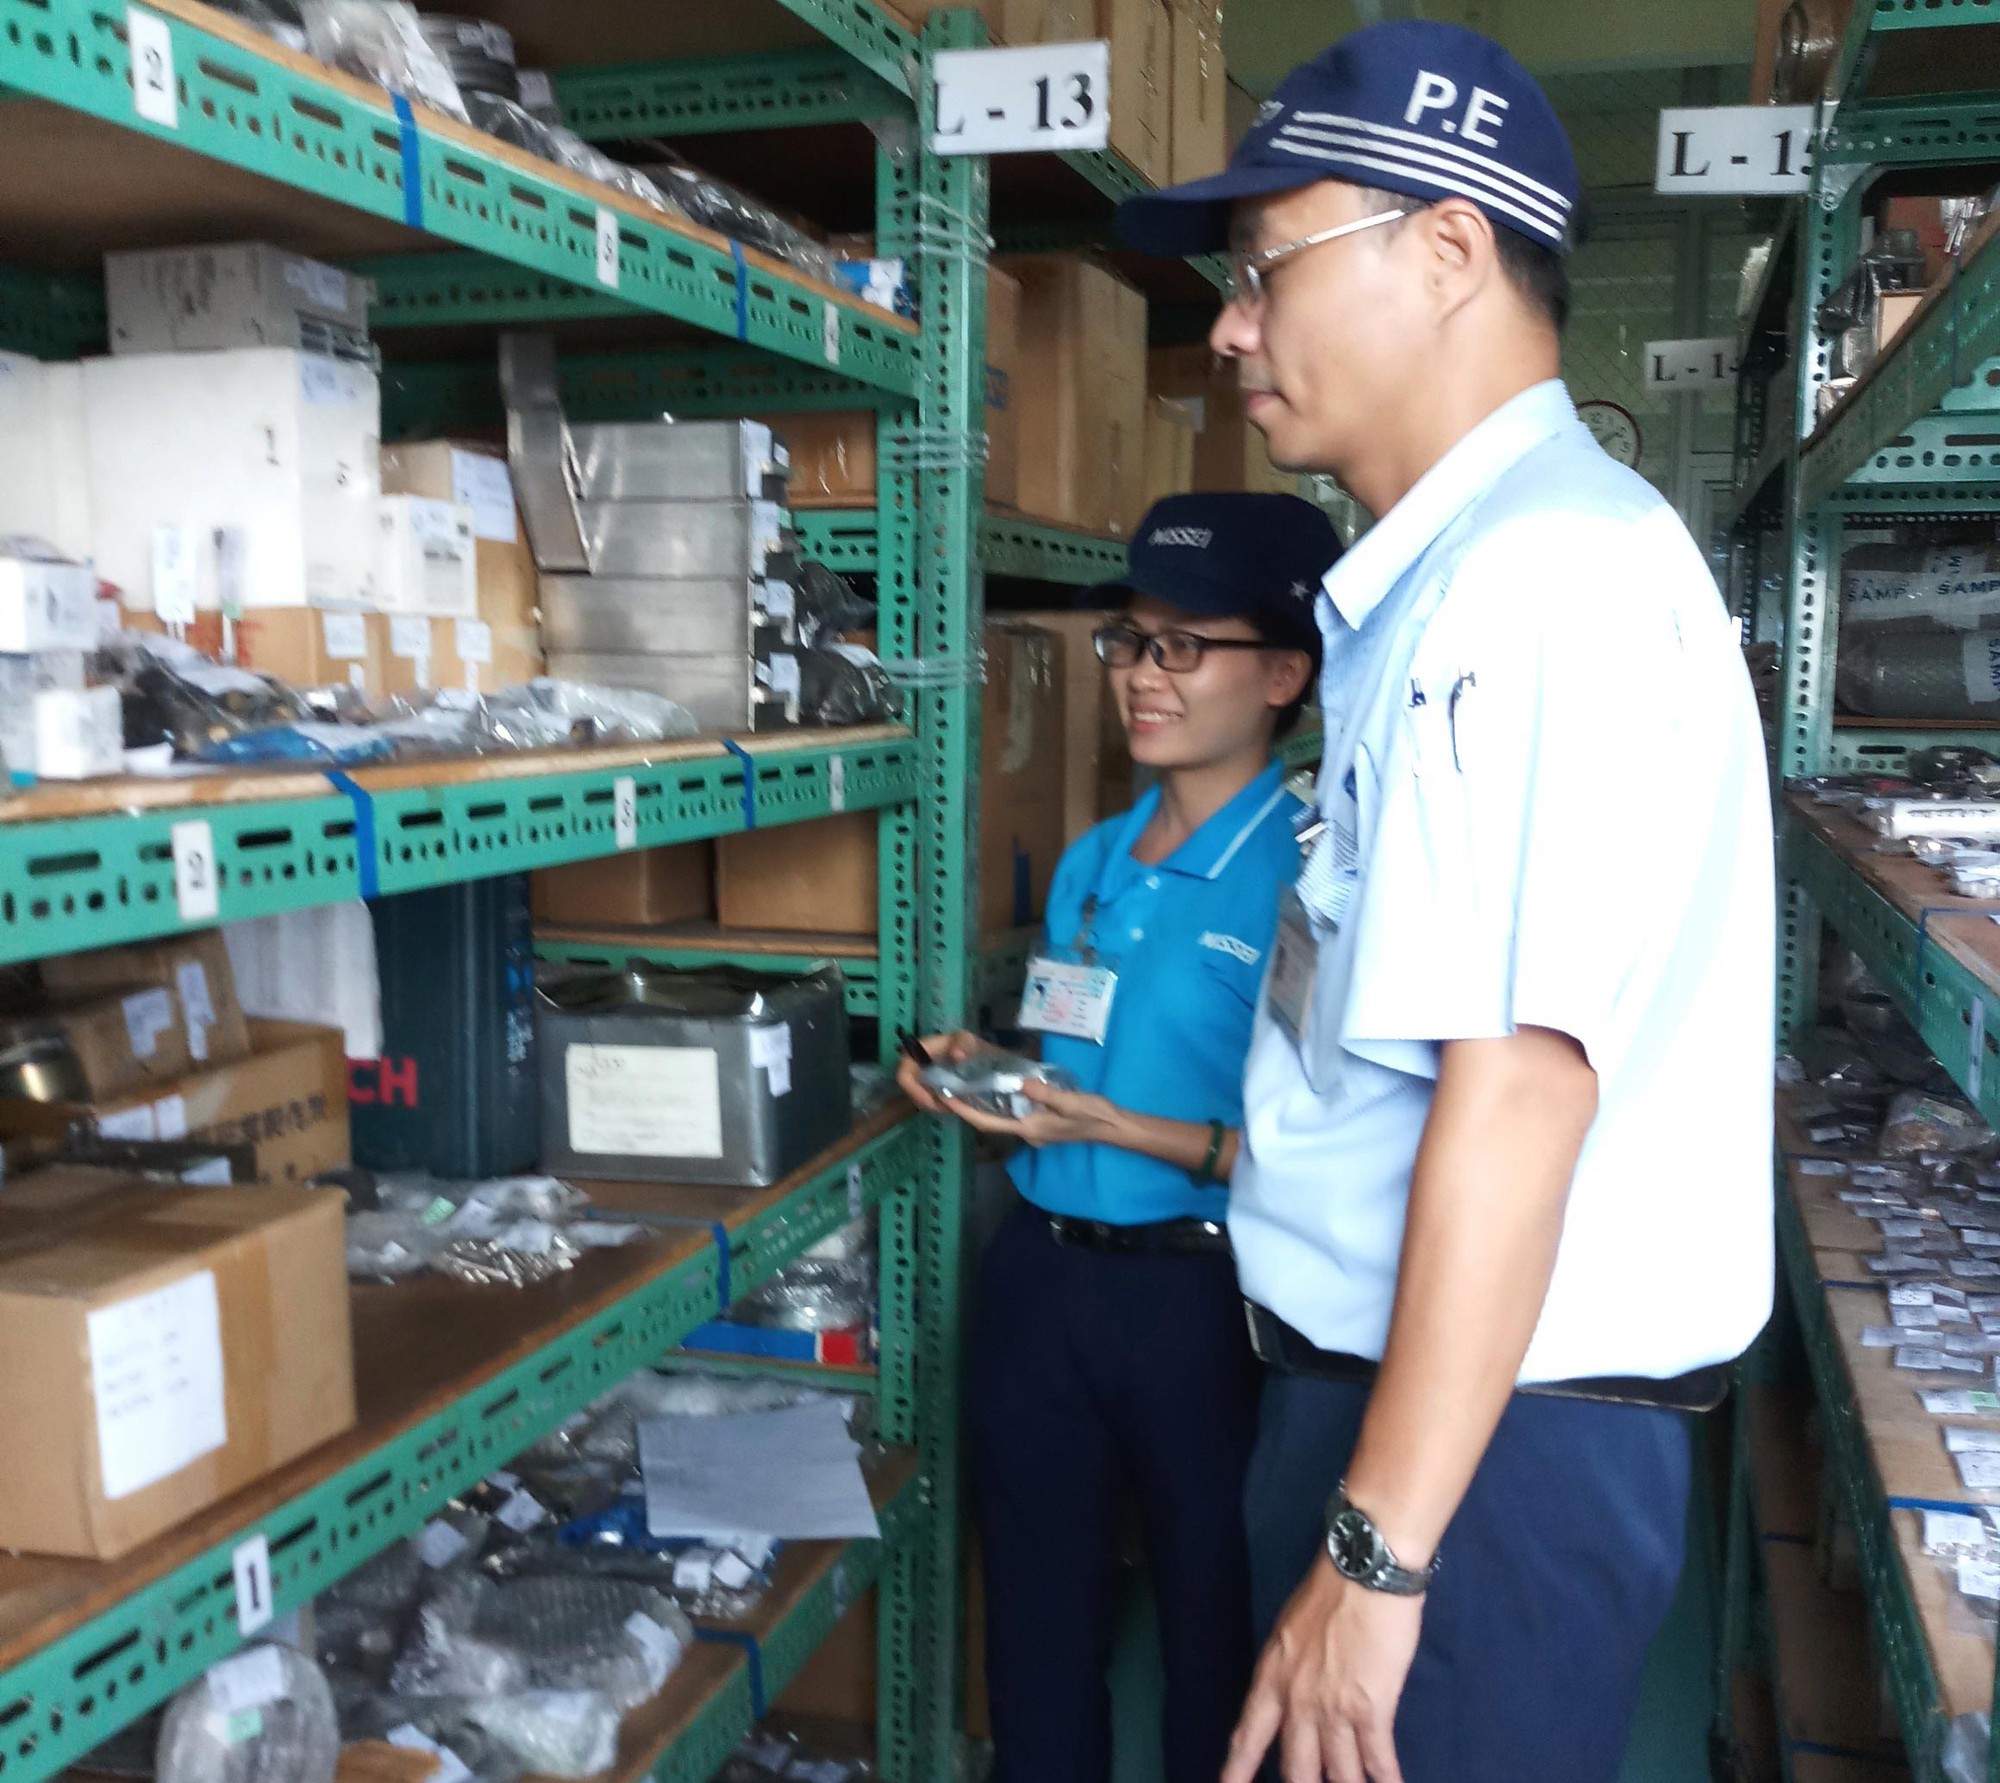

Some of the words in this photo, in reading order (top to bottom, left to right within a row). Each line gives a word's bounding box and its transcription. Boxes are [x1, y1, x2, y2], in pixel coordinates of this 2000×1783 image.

[144, 45, 164, 92] 2
[933, 80, 965, 135] L
[1031, 72, 1094, 132] 13
[1403, 69, 1510, 149] P.E
[1668, 131, 1711, 177] L
[1652, 354, 1677, 381] L
[187, 851, 206, 890] 2
